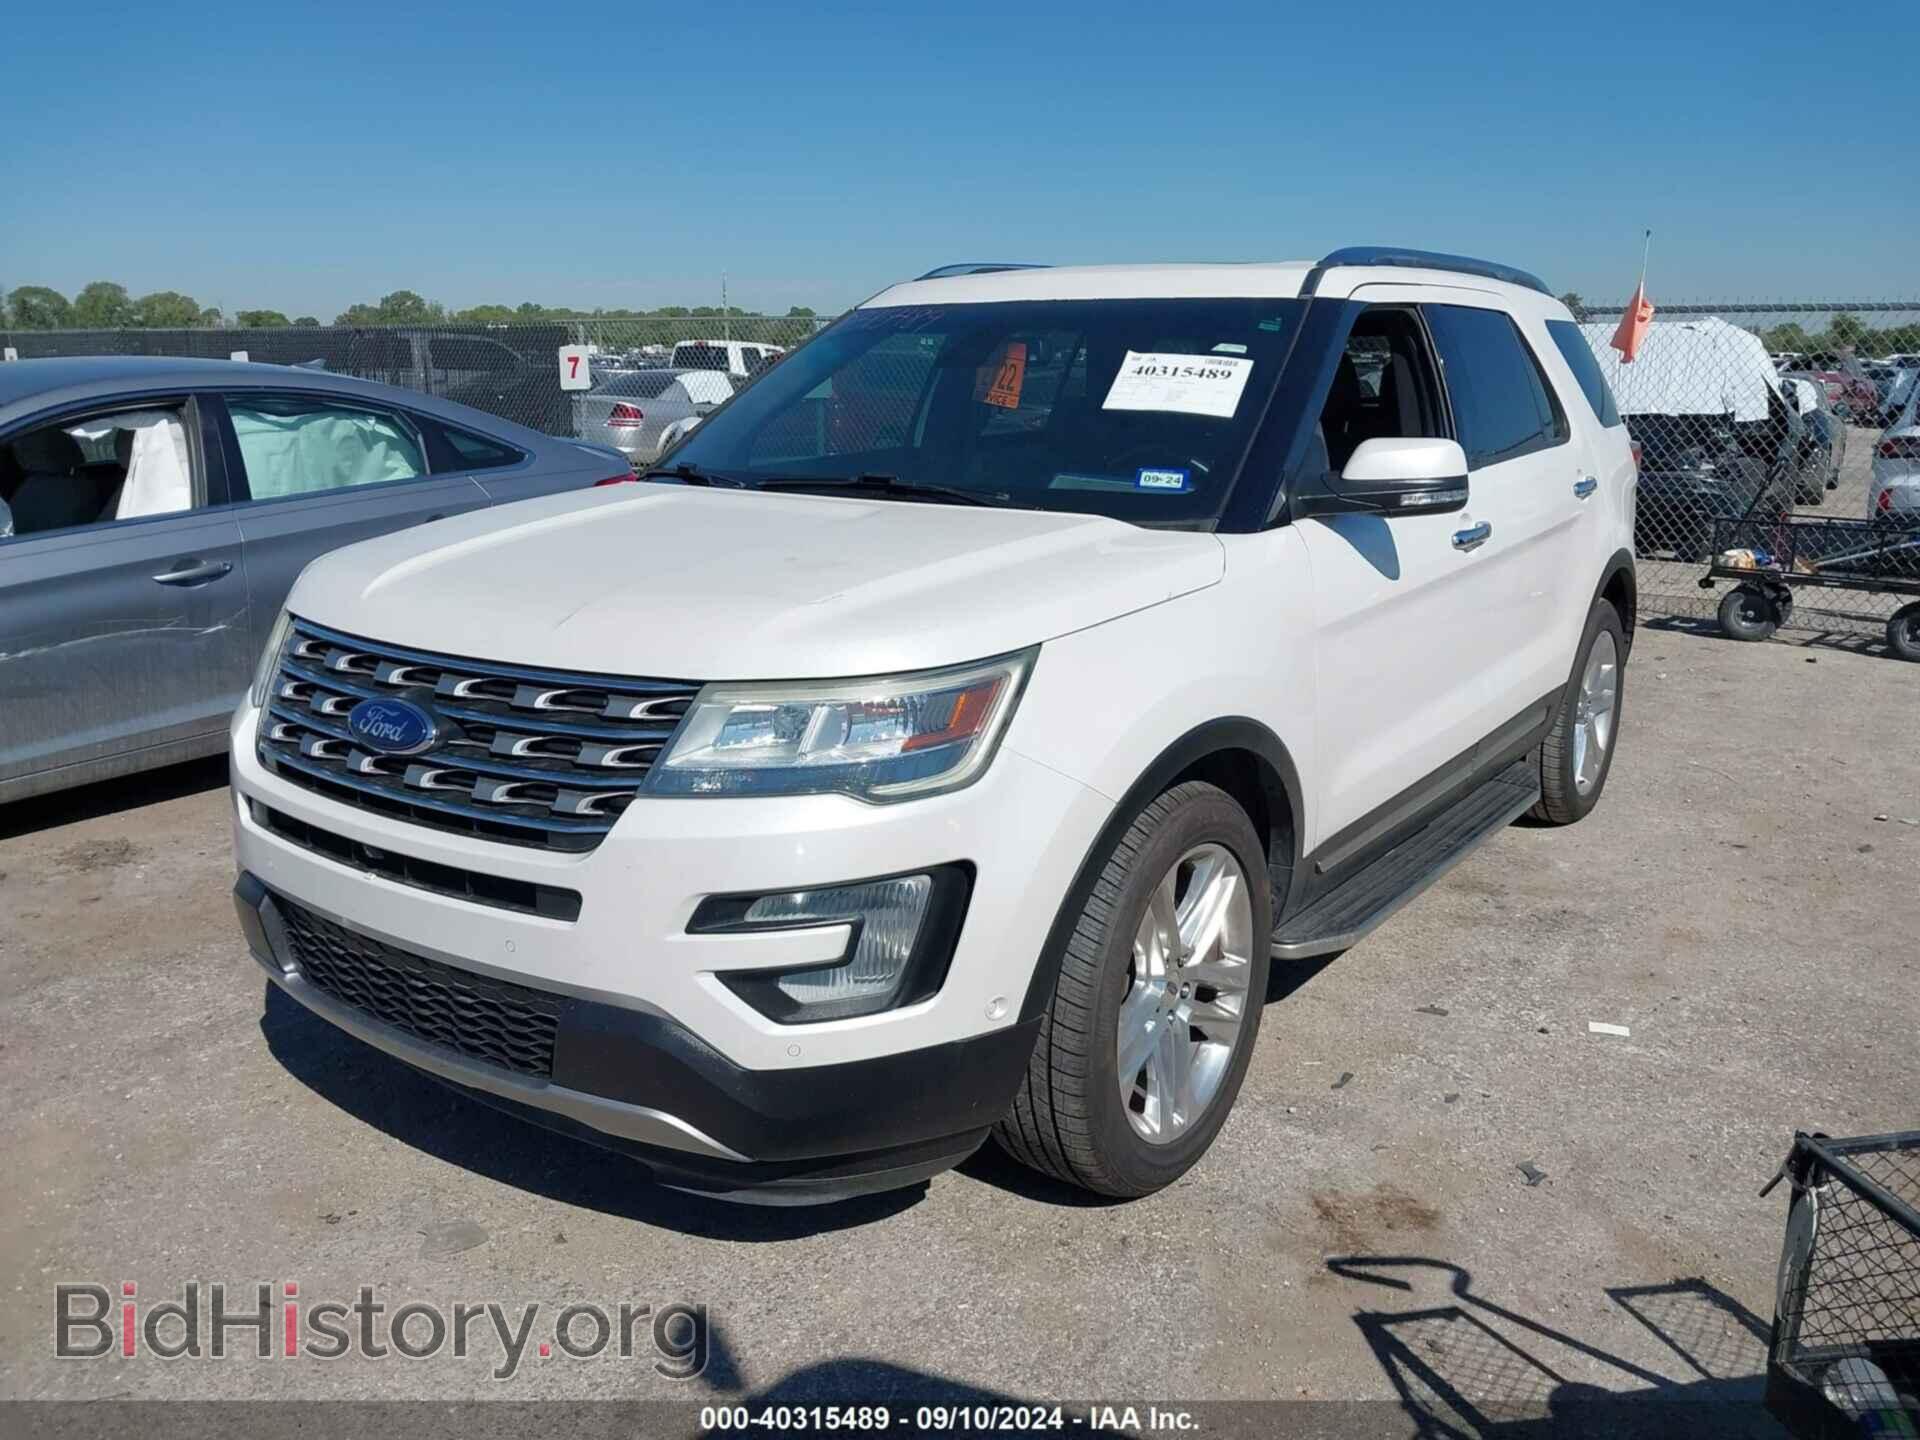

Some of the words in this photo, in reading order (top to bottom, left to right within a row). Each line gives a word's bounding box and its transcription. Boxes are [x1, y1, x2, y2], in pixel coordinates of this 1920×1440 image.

[567, 356, 580, 379] 7
[1131, 365, 1233, 380] 40315489
[359, 705, 409, 742] Ford
